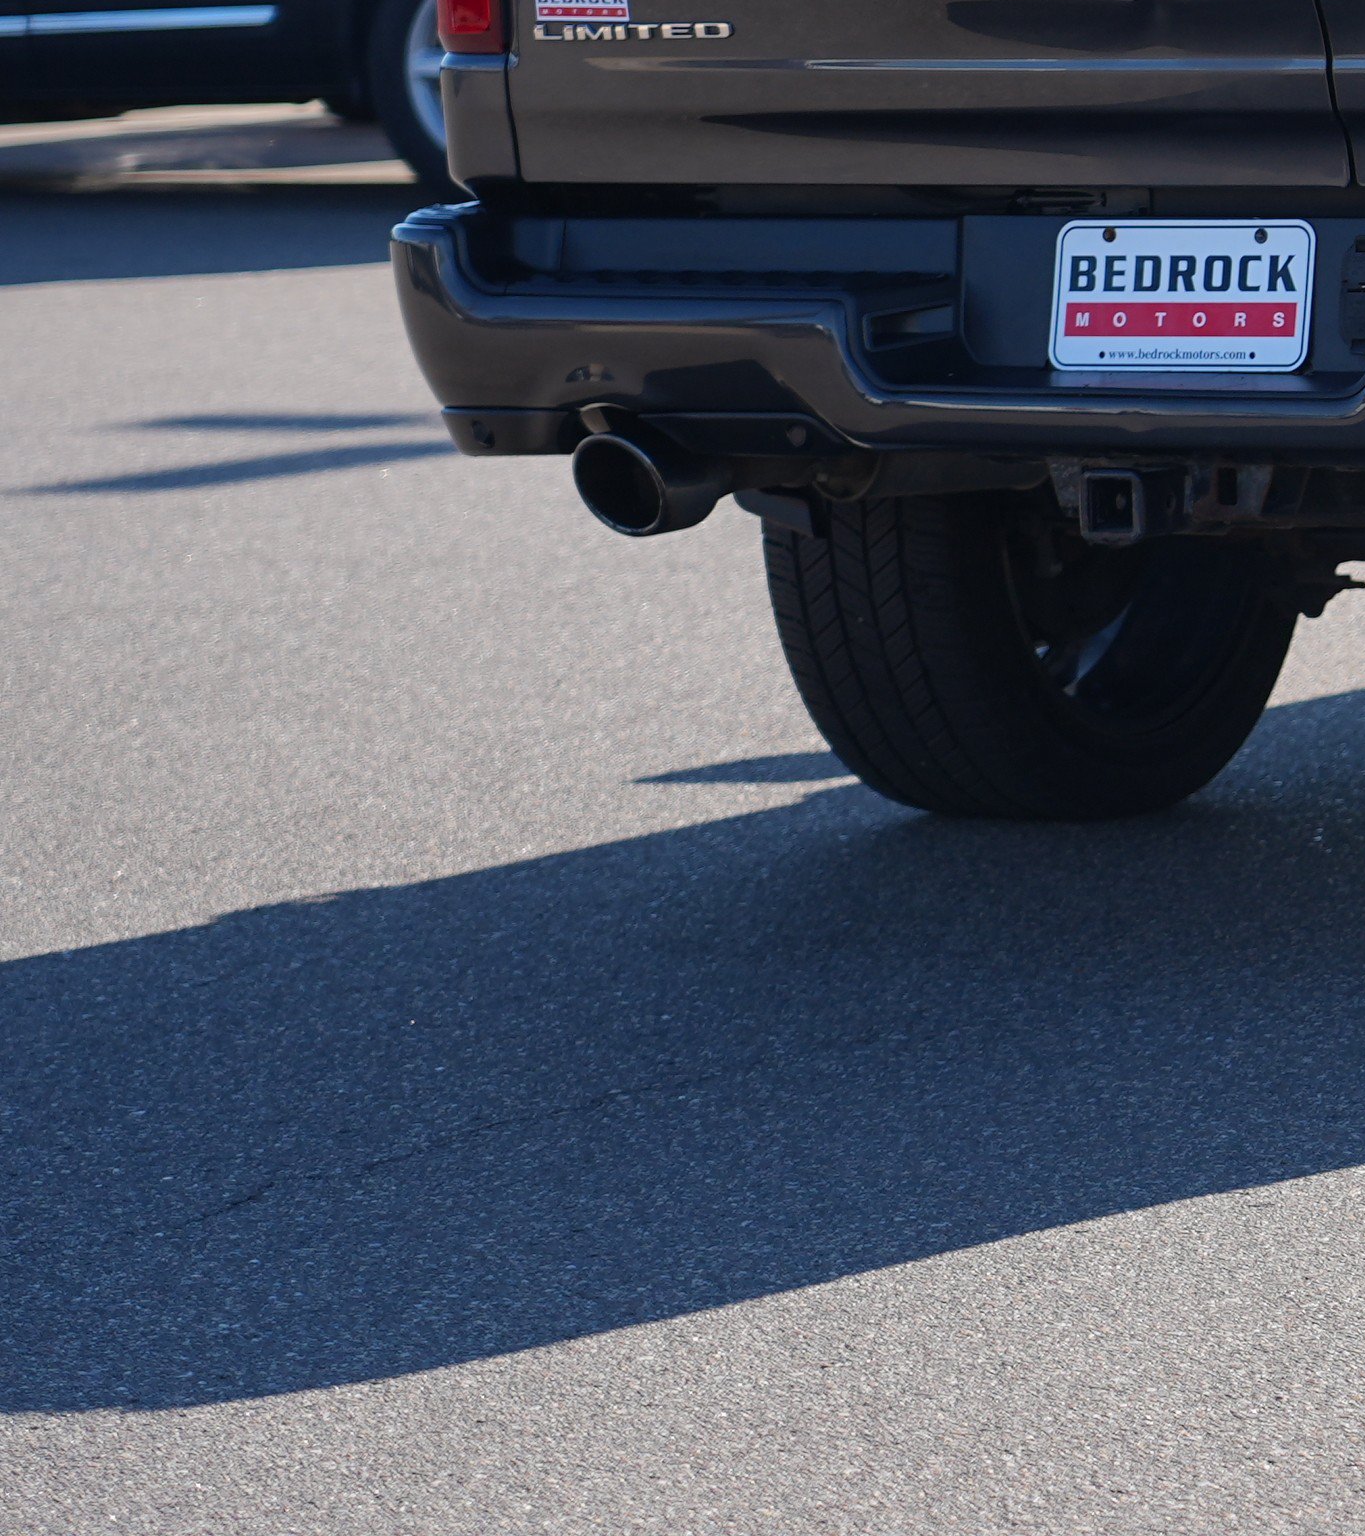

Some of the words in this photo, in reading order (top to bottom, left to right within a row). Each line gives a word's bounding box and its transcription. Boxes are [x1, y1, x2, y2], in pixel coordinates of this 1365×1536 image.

[533, 22, 735, 41] LIMITED
[1068, 255, 1298, 292] BEDROCK
[1075, 311, 1286, 328] MOTORS
[1108, 348, 1247, 360] www.bedrockmotors.com
